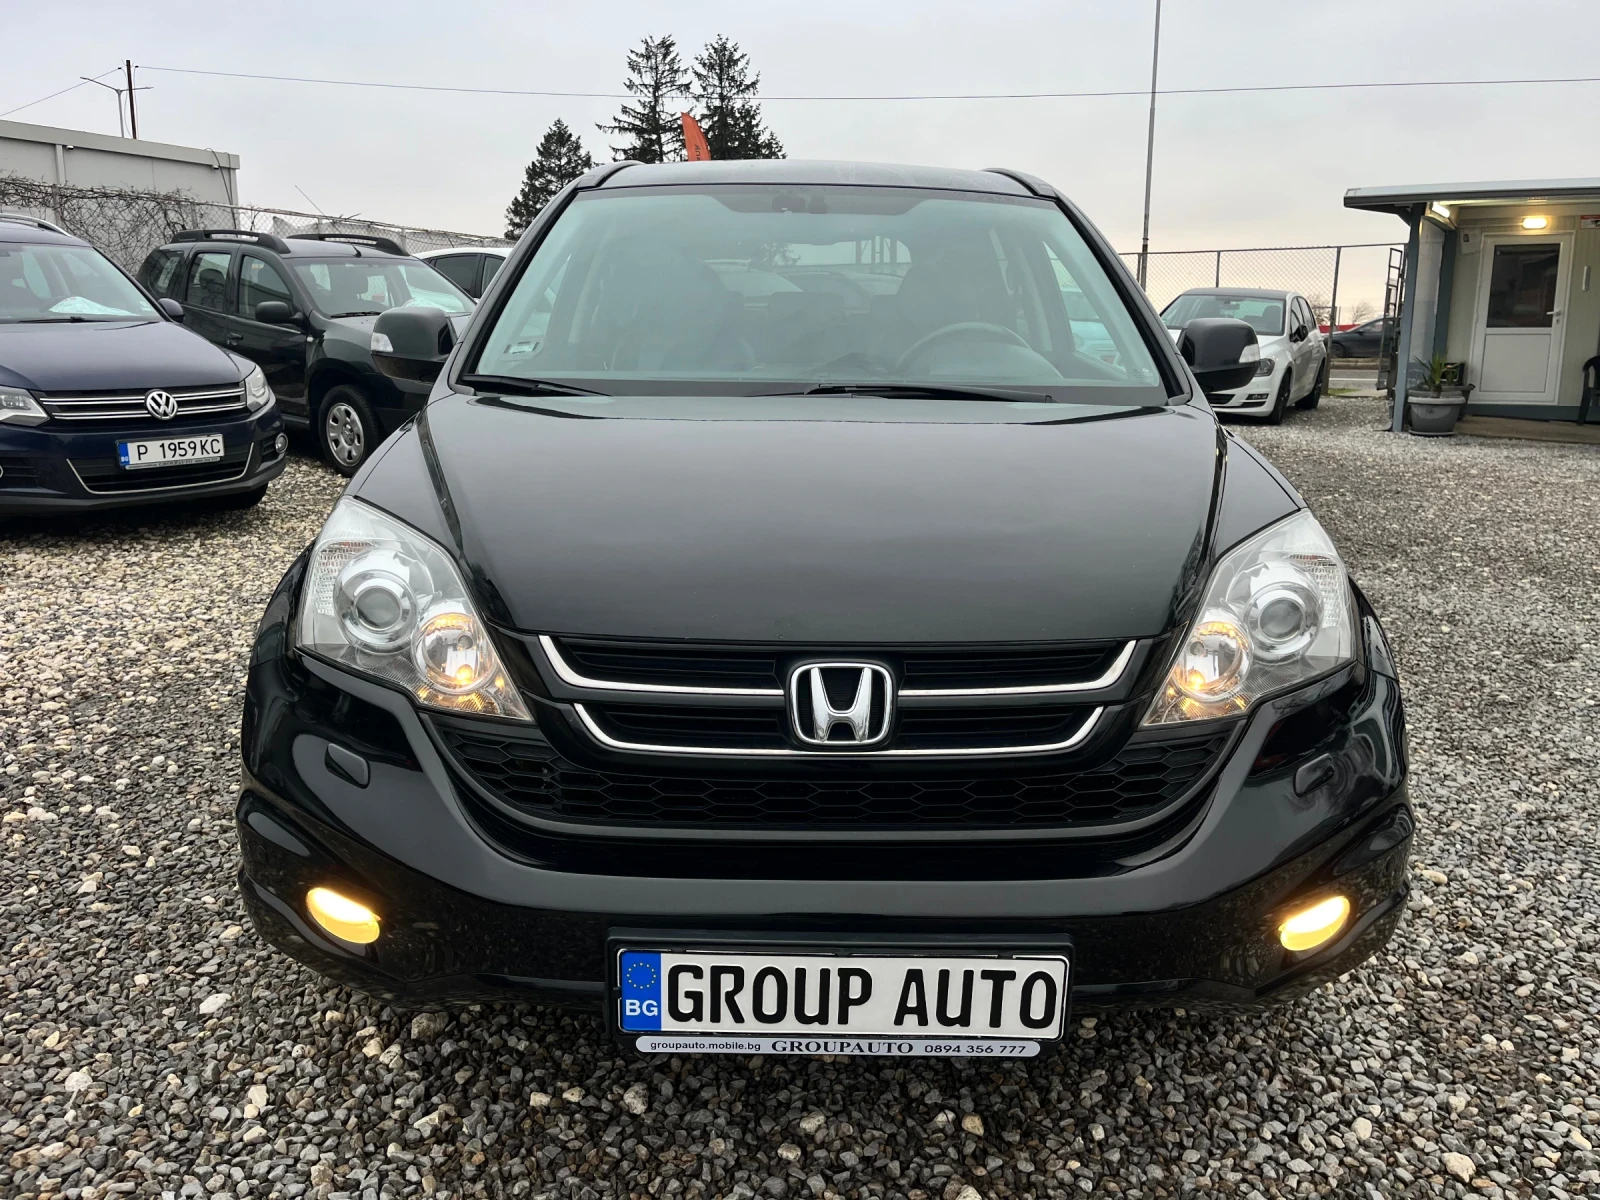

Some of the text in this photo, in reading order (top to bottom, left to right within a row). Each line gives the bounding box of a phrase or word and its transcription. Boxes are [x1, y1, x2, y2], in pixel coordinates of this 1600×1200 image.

[137, 444, 148, 460] P
[667, 963, 1057, 1030] GROUP AUTO
[625, 999, 659, 1017] BG
[650, 1040, 1027, 1055] groupauto.mobile.bg GROUPAUTO 0894 356 777
